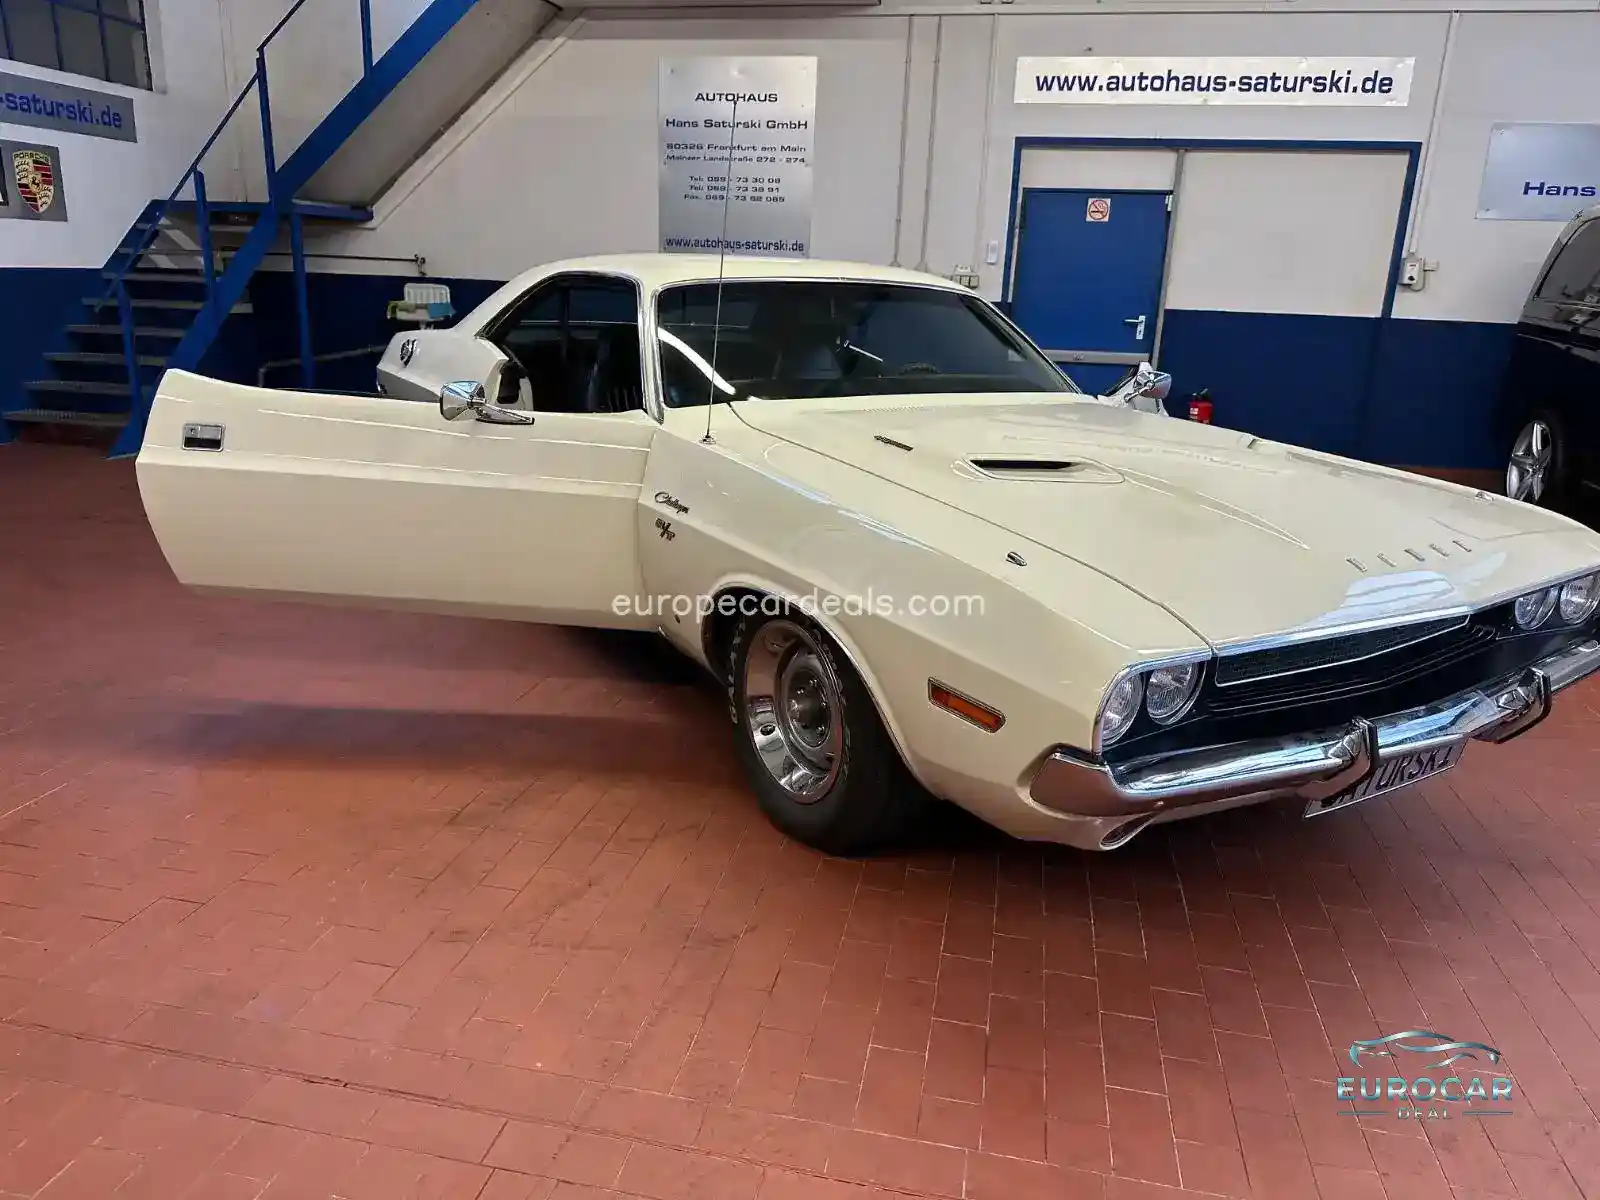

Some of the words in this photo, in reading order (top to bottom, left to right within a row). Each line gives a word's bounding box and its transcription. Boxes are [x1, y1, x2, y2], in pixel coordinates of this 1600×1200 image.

[1035, 69, 1394, 94] www.autohaus-saturski.de
[695, 92, 779, 103] AUTOHAUS
[665, 118, 699, 129] Hans
[703, 118, 761, 130] Saturski
[766, 120, 808, 131] GmbH
[707, 143, 758, 152] Frankfurt
[780, 144, 806, 152] Main
[13, 151, 49, 163] PORSCHE
[1523, 181, 1597, 197] Hans
[665, 237, 804, 252] www.autohaus-saturski.de
